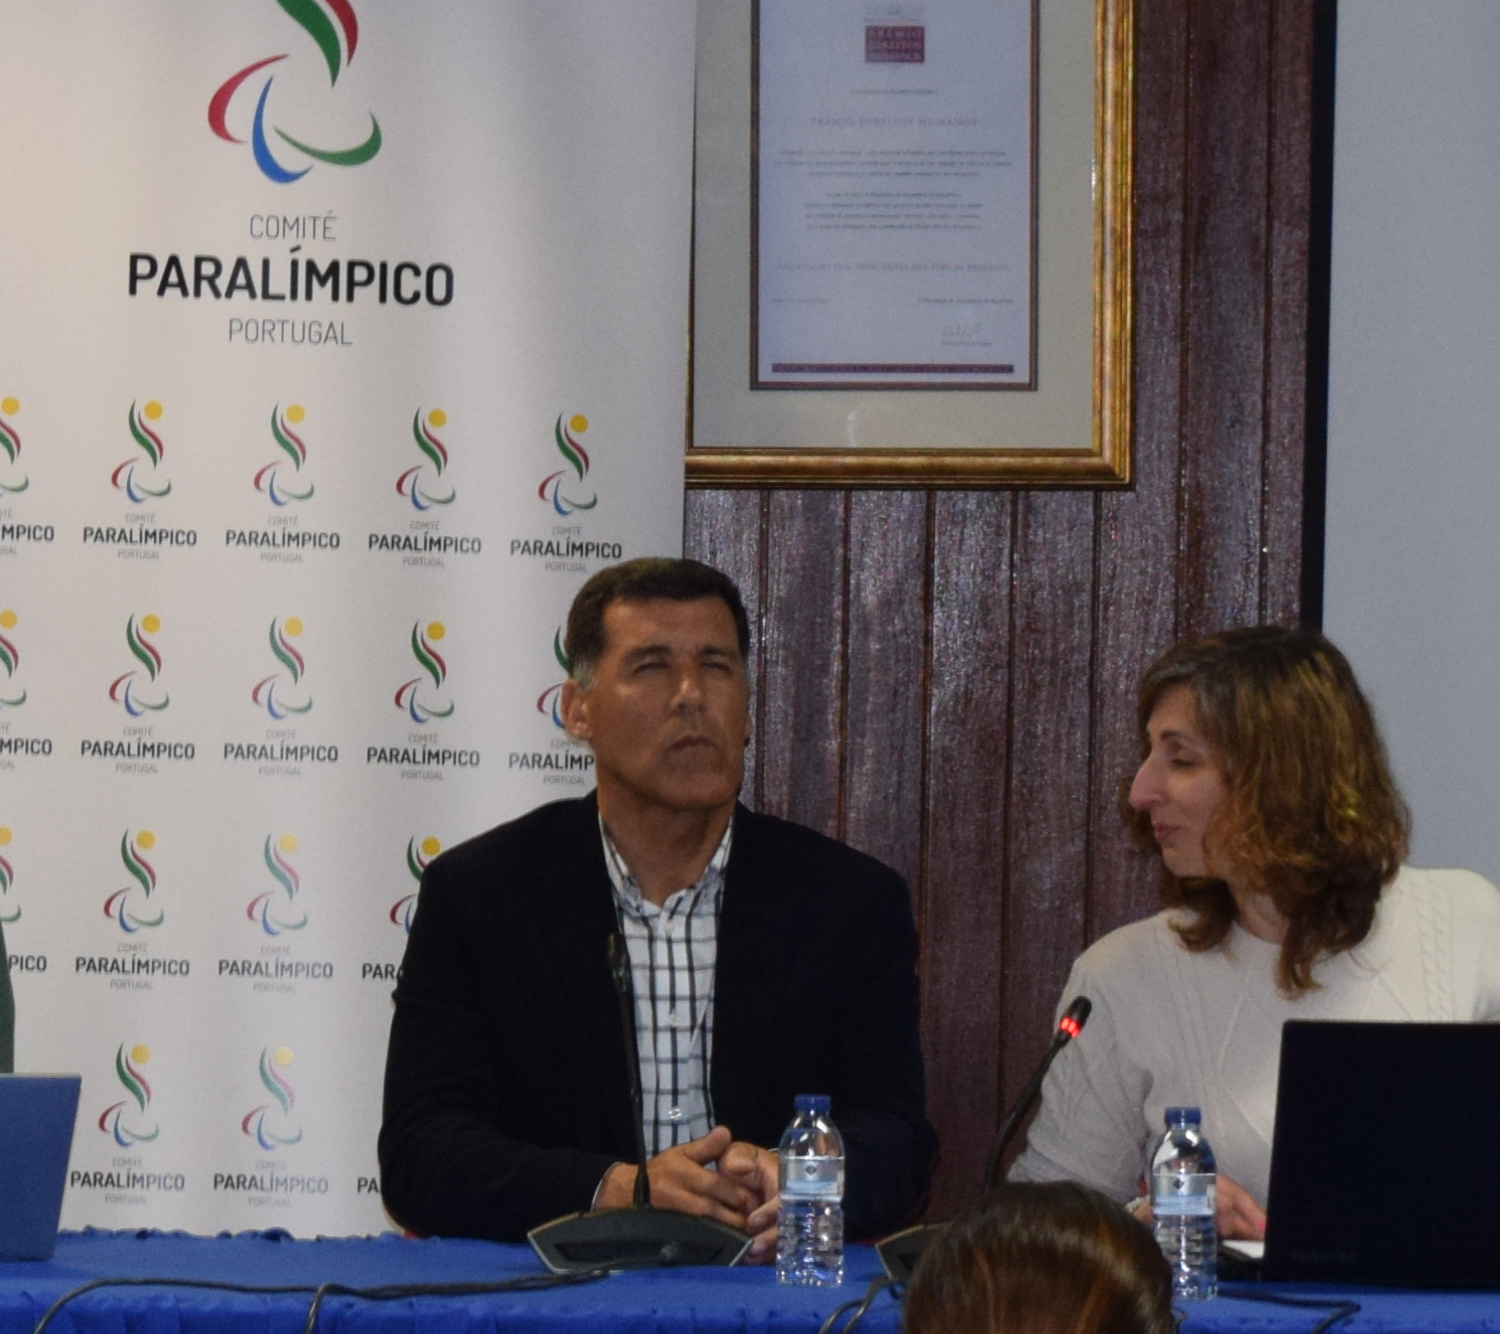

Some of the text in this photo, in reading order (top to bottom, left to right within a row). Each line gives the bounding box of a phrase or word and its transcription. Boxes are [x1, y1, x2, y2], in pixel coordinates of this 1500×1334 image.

[250, 210, 337, 241] COMITÉ
[128, 245, 455, 307] PARALÍMPICO
[228, 318, 353, 346] PORTUGAL
[83, 522, 198, 545] PARALÍMPICO
[226, 525, 341, 548] PARALÍMPICO
[368, 530, 482, 553] PARALÍMPICO
[510, 536, 622, 559] PARALÍMPICO
[81, 736, 195, 759] PARALÍMPICO
[223, 739, 339, 762] PARALÍMPICO
[367, 744, 480, 767] PARALÍMPICO
[508, 750, 595, 770] PARALÍMP
[75, 953, 190, 976] PARALÍMPICO
[218, 956, 334, 979] PARALÍMPICO
[70, 1168, 185, 1191] PARALÍMPICO
[213, 1171, 329, 1194] PARALÍMPICO
